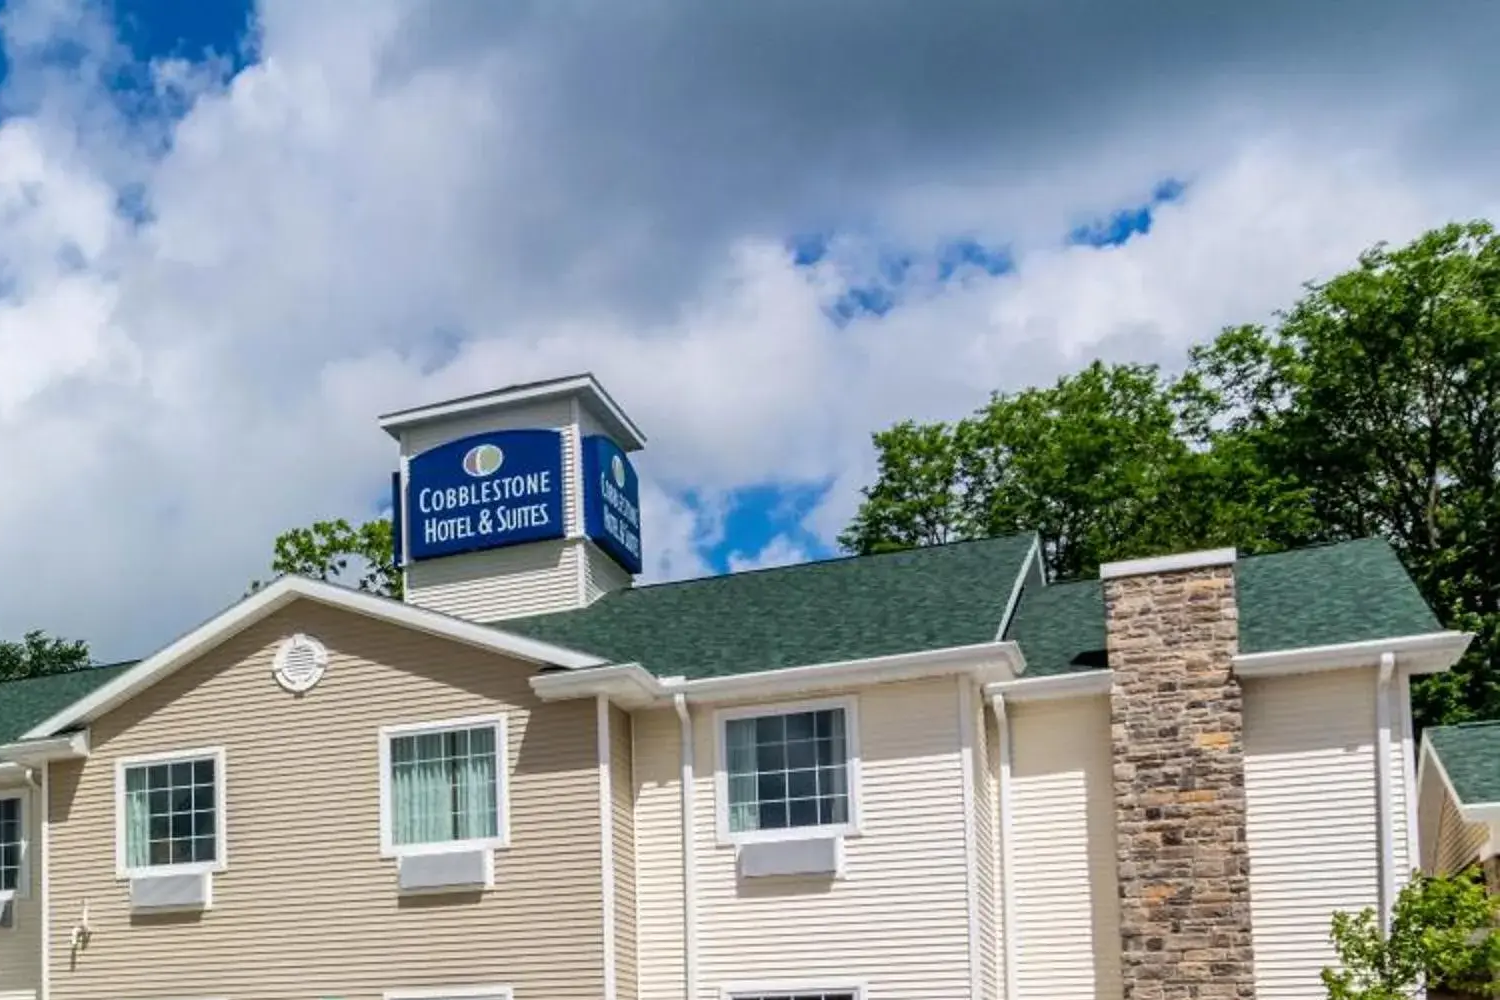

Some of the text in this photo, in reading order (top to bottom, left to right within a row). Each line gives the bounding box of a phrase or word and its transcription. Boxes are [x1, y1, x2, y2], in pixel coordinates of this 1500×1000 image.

[420, 471, 551, 512] COBBLESTONE
[425, 503, 549, 544] HOTEL & SUITES
